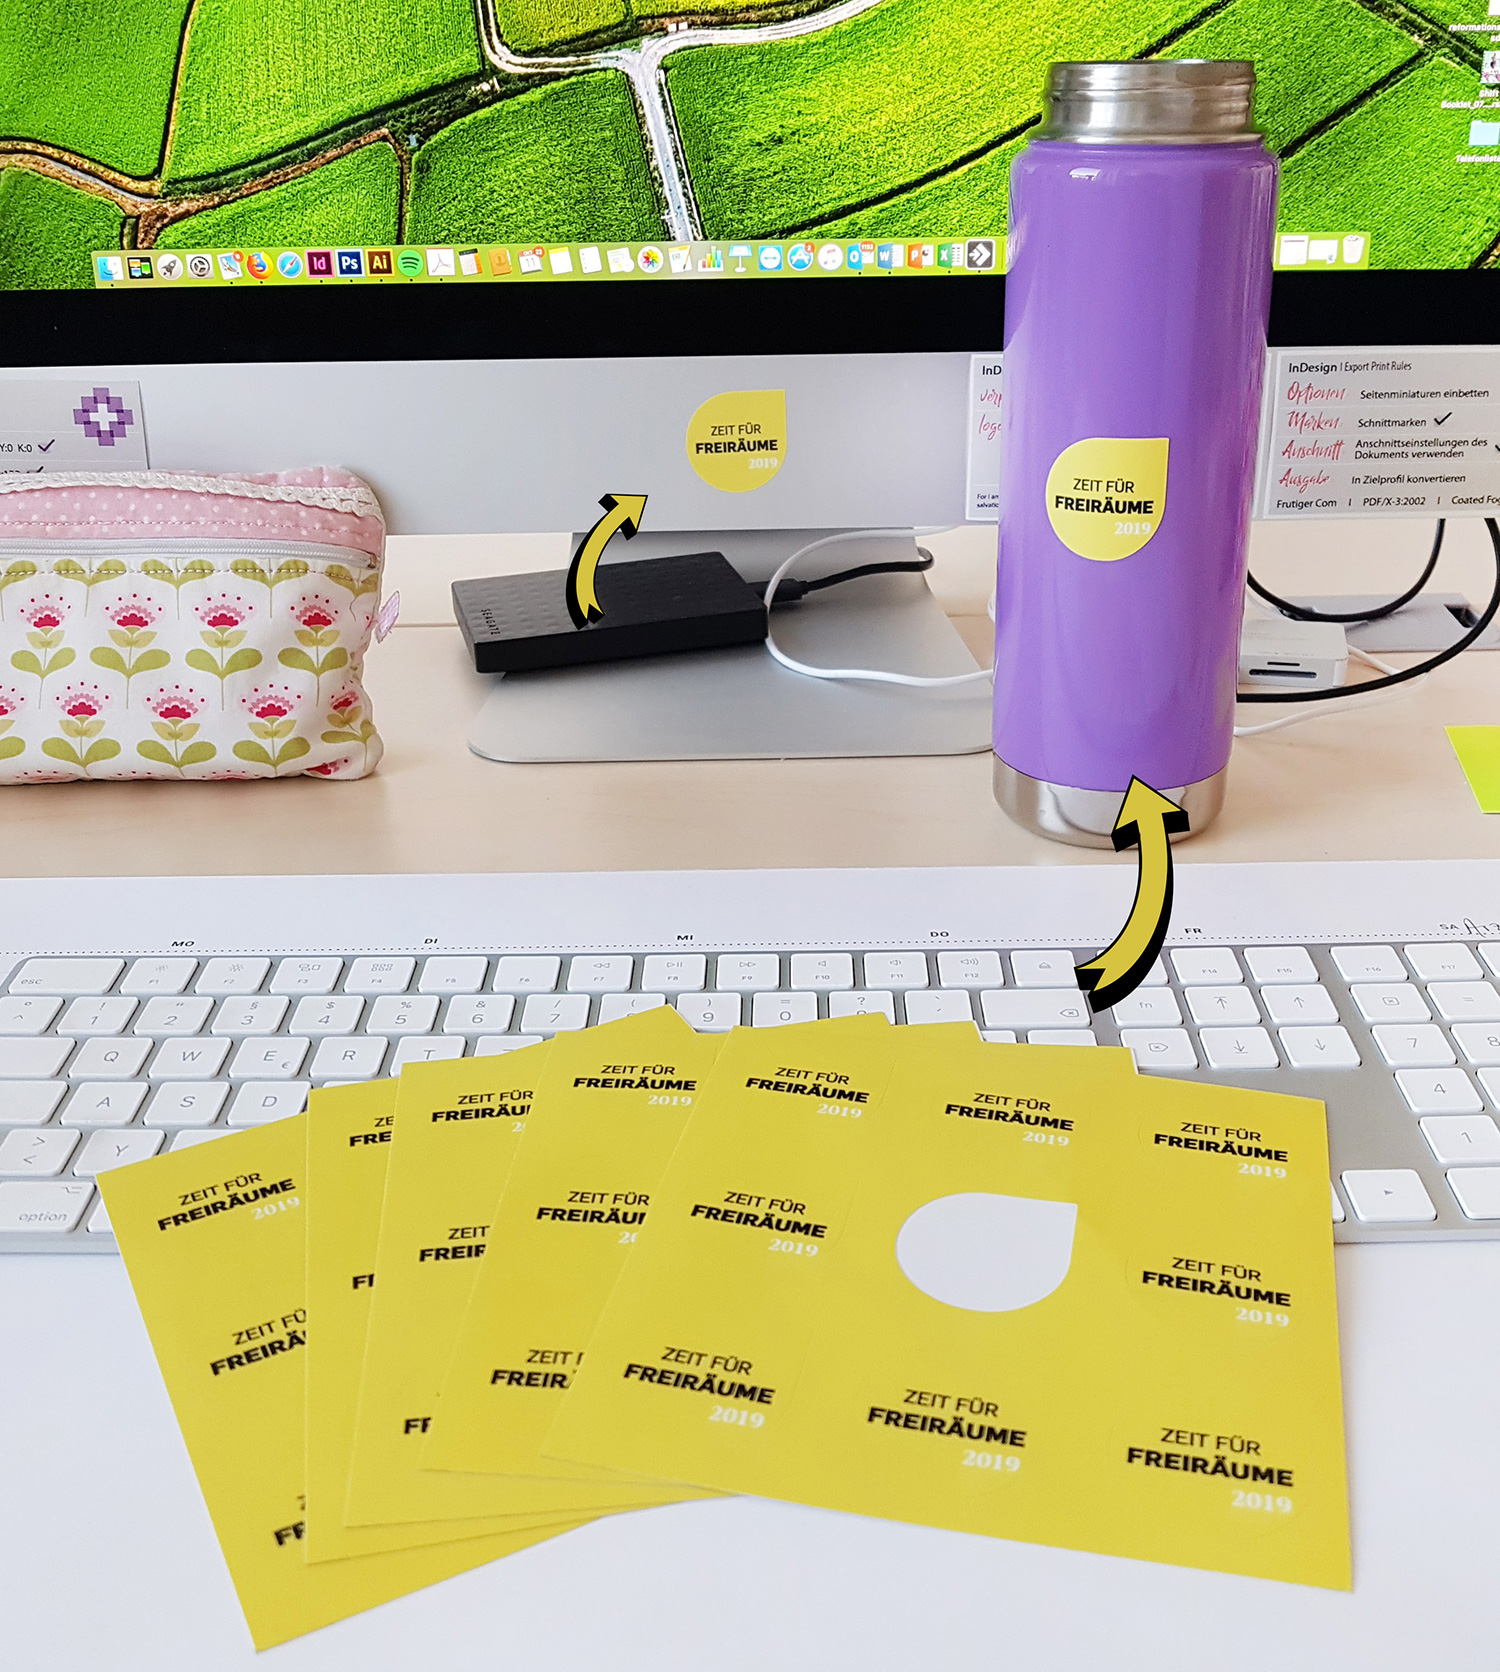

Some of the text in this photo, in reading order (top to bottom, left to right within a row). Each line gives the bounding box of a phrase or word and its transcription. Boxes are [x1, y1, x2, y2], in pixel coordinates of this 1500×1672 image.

[1479, 89, 1499, 97] Shift
[313, 256, 327, 270] Id
[341, 255, 359, 270] Ps
[372, 254, 388, 270] Ai
[880, 250, 891, 261] W
[911, 250, 919, 261] P
[940, 250, 949, 261] X
[1288, 360, 1412, 375] InDesign Export Print Rules
[1287, 381, 1490, 405] Optionen Seitenminiaturen einbetten
[711, 422, 761, 436] ZEIT FÜR
[1287, 410, 1427, 434] Marken Schnittmarken
[695, 438, 778, 454] FREIRÄUME
[1282, 439, 1345, 461] Anschnitt
[1355, 437, 1488, 450] Anschnittseinstellungen des
[1354, 448, 1465, 460] Dokuments verwenden
[749, 457, 778, 469] 2019
[1073, 478, 1134, 493] ZEIT FÜR
[1279, 467, 1466, 493] Ausgabe In Zielprofil konvertieren
[1055, 495, 1154, 514] FREIRÄUME
[1276, 498, 1313, 510] Frutiger
[1315, 498, 1337, 508] Com
[1363, 496, 1426, 507] PDF/X-3:2002
[1451, 495, 1485, 504] Coated
[1114, 522, 1152, 535] 2019
[1139, 1001, 1153, 1009] fn
[163, 1015, 177, 1026] 2
[241, 1015, 254, 1025] 3
[318, 1014, 331, 1025] 4
[394, 1014, 408, 1025] 5
[471, 1013, 484, 1024] 6
[550, 1013, 560, 1024] 7
[702, 1012, 714, 1022] 9
[779, 1011, 791, 1021] 0
[1406, 1037, 1418, 1048] 7
[1487, 1036, 1500, 1047] 8
[104, 1050, 119, 1062] Q
[181, 1050, 202, 1062] W
[263, 1050, 277, 1062] E
[342, 1050, 356, 1061] R
[601, 1064, 675, 1076] ZEIT FÜR
[775, 1067, 850, 1085] ZEIT FÜR
[573, 1077, 697, 1091] FREIRÄUME
[745, 1077, 870, 1103] FREIRÄUME
[1434, 1083, 1446, 1094] 4
[96, 1096, 111, 1108] A
[180, 1096, 196, 1108] S
[261, 1096, 277, 1108] D
[458, 1089, 534, 1105] ZEIT FÜR
[648, 1094, 692, 1106] 2019
[973, 1092, 1051, 1112] ZEIT FÜR
[432, 1104, 531, 1122] FREIRÄU
[817, 1103, 862, 1118] 2019
[945, 1103, 1074, 1131] FREIRÄUME
[1022, 1131, 1070, 1147] 2019
[1181, 1122, 1262, 1142] ZEIT FÜR
[1461, 1132, 1472, 1143] 1
[116, 1144, 129, 1157] Y
[1154, 1133, 1288, 1162] FREIRÄUME
[1238, 1162, 1287, 1179] 2019
[178, 1172, 262, 1206] ZEIT FÜR
[157, 1178, 296, 1231] FREIRÄUME
[568, 1191, 650, 1206] ZEIT FÜR
[724, 1191, 806, 1215] ZEIT FÜR
[252, 1196, 300, 1221] 2019
[18, 1211, 68, 1223] option
[690, 1204, 828, 1238] FREIRÄUME
[448, 1225, 491, 1240] ZEIT
[768, 1238, 819, 1257] 2019
[1172, 1257, 1262, 1282] ZEIT FÜR
[1142, 1270, 1291, 1307] FREIRÄUME
[1235, 1307, 1290, 1327] 2019
[232, 1320, 276, 1346] ZEIT
[209, 1330, 307, 1376] FREIRÄ
[527, 1349, 573, 1365] ZEIT
[661, 1346, 753, 1375] ZEIT FÜR
[624, 1363, 776, 1405] FREIRÄUME
[904, 1388, 999, 1418] ZEIT FÜR
[709, 1405, 765, 1429] 2019
[867, 1406, 1027, 1448] FREIRÄUME
[1161, 1427, 1261, 1456] ZEIT FÜR
[962, 1450, 1021, 1473] 2019
[1127, 1446, 1294, 1487] FREIRÄUME
[1231, 1489, 1293, 1514] 2019
